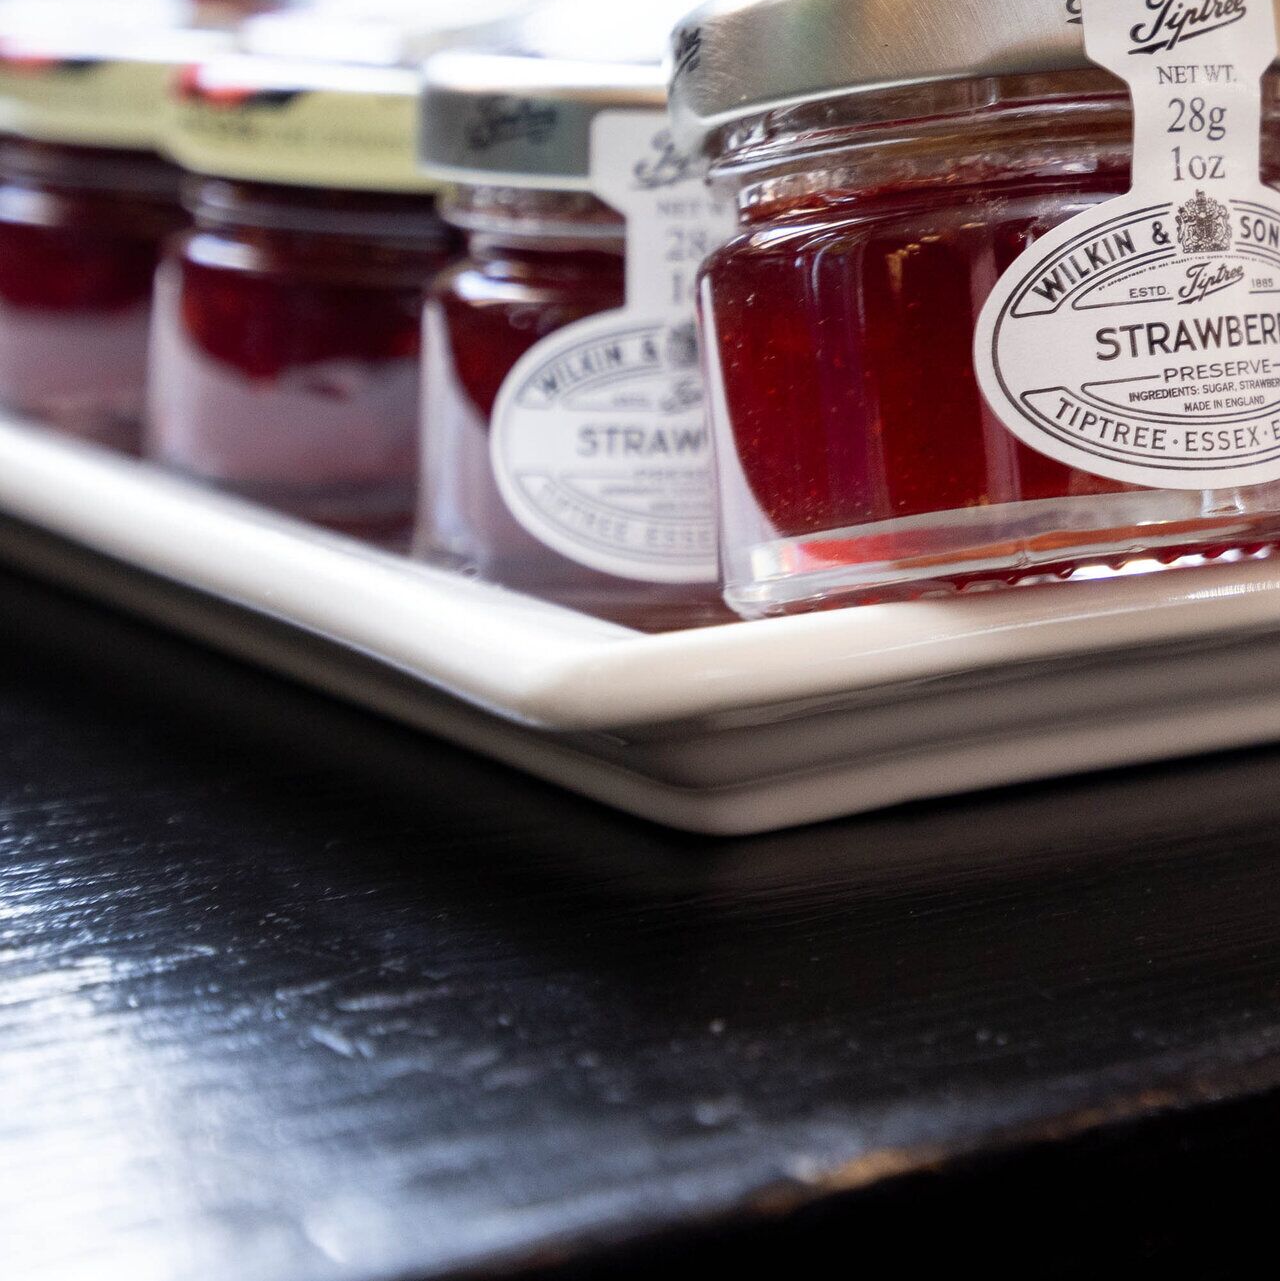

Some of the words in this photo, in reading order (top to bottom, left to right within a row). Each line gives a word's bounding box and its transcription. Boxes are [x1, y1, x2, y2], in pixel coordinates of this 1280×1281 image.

[1156, 65, 1199, 85] NET
[1204, 64, 1237, 83] WT.
[1167, 96, 1228, 141] 28g
[1171, 145, 1226, 182] 1oz
[1031, 228, 1137, 304] WILKIN
[1151, 220, 1172, 245] &
[1129, 285, 1170, 299] ESTD.
[1177, 262, 1245, 305] Tiptree
[1251, 277, 1274, 289] 1885
[1163, 358, 1272, 384] PRESERVE
[1129, 386, 1200, 403] INGREDIENTS:
[1202, 381, 1238, 395] SUGAR,
[1184, 400, 1212, 413] MADE
[1214, 399, 1223, 410] IN
[1225, 394, 1265, 408] ENGLAND
[1054, 396, 1168, 451] TIPTREE
[1185, 426, 1261, 453] ESSEX
